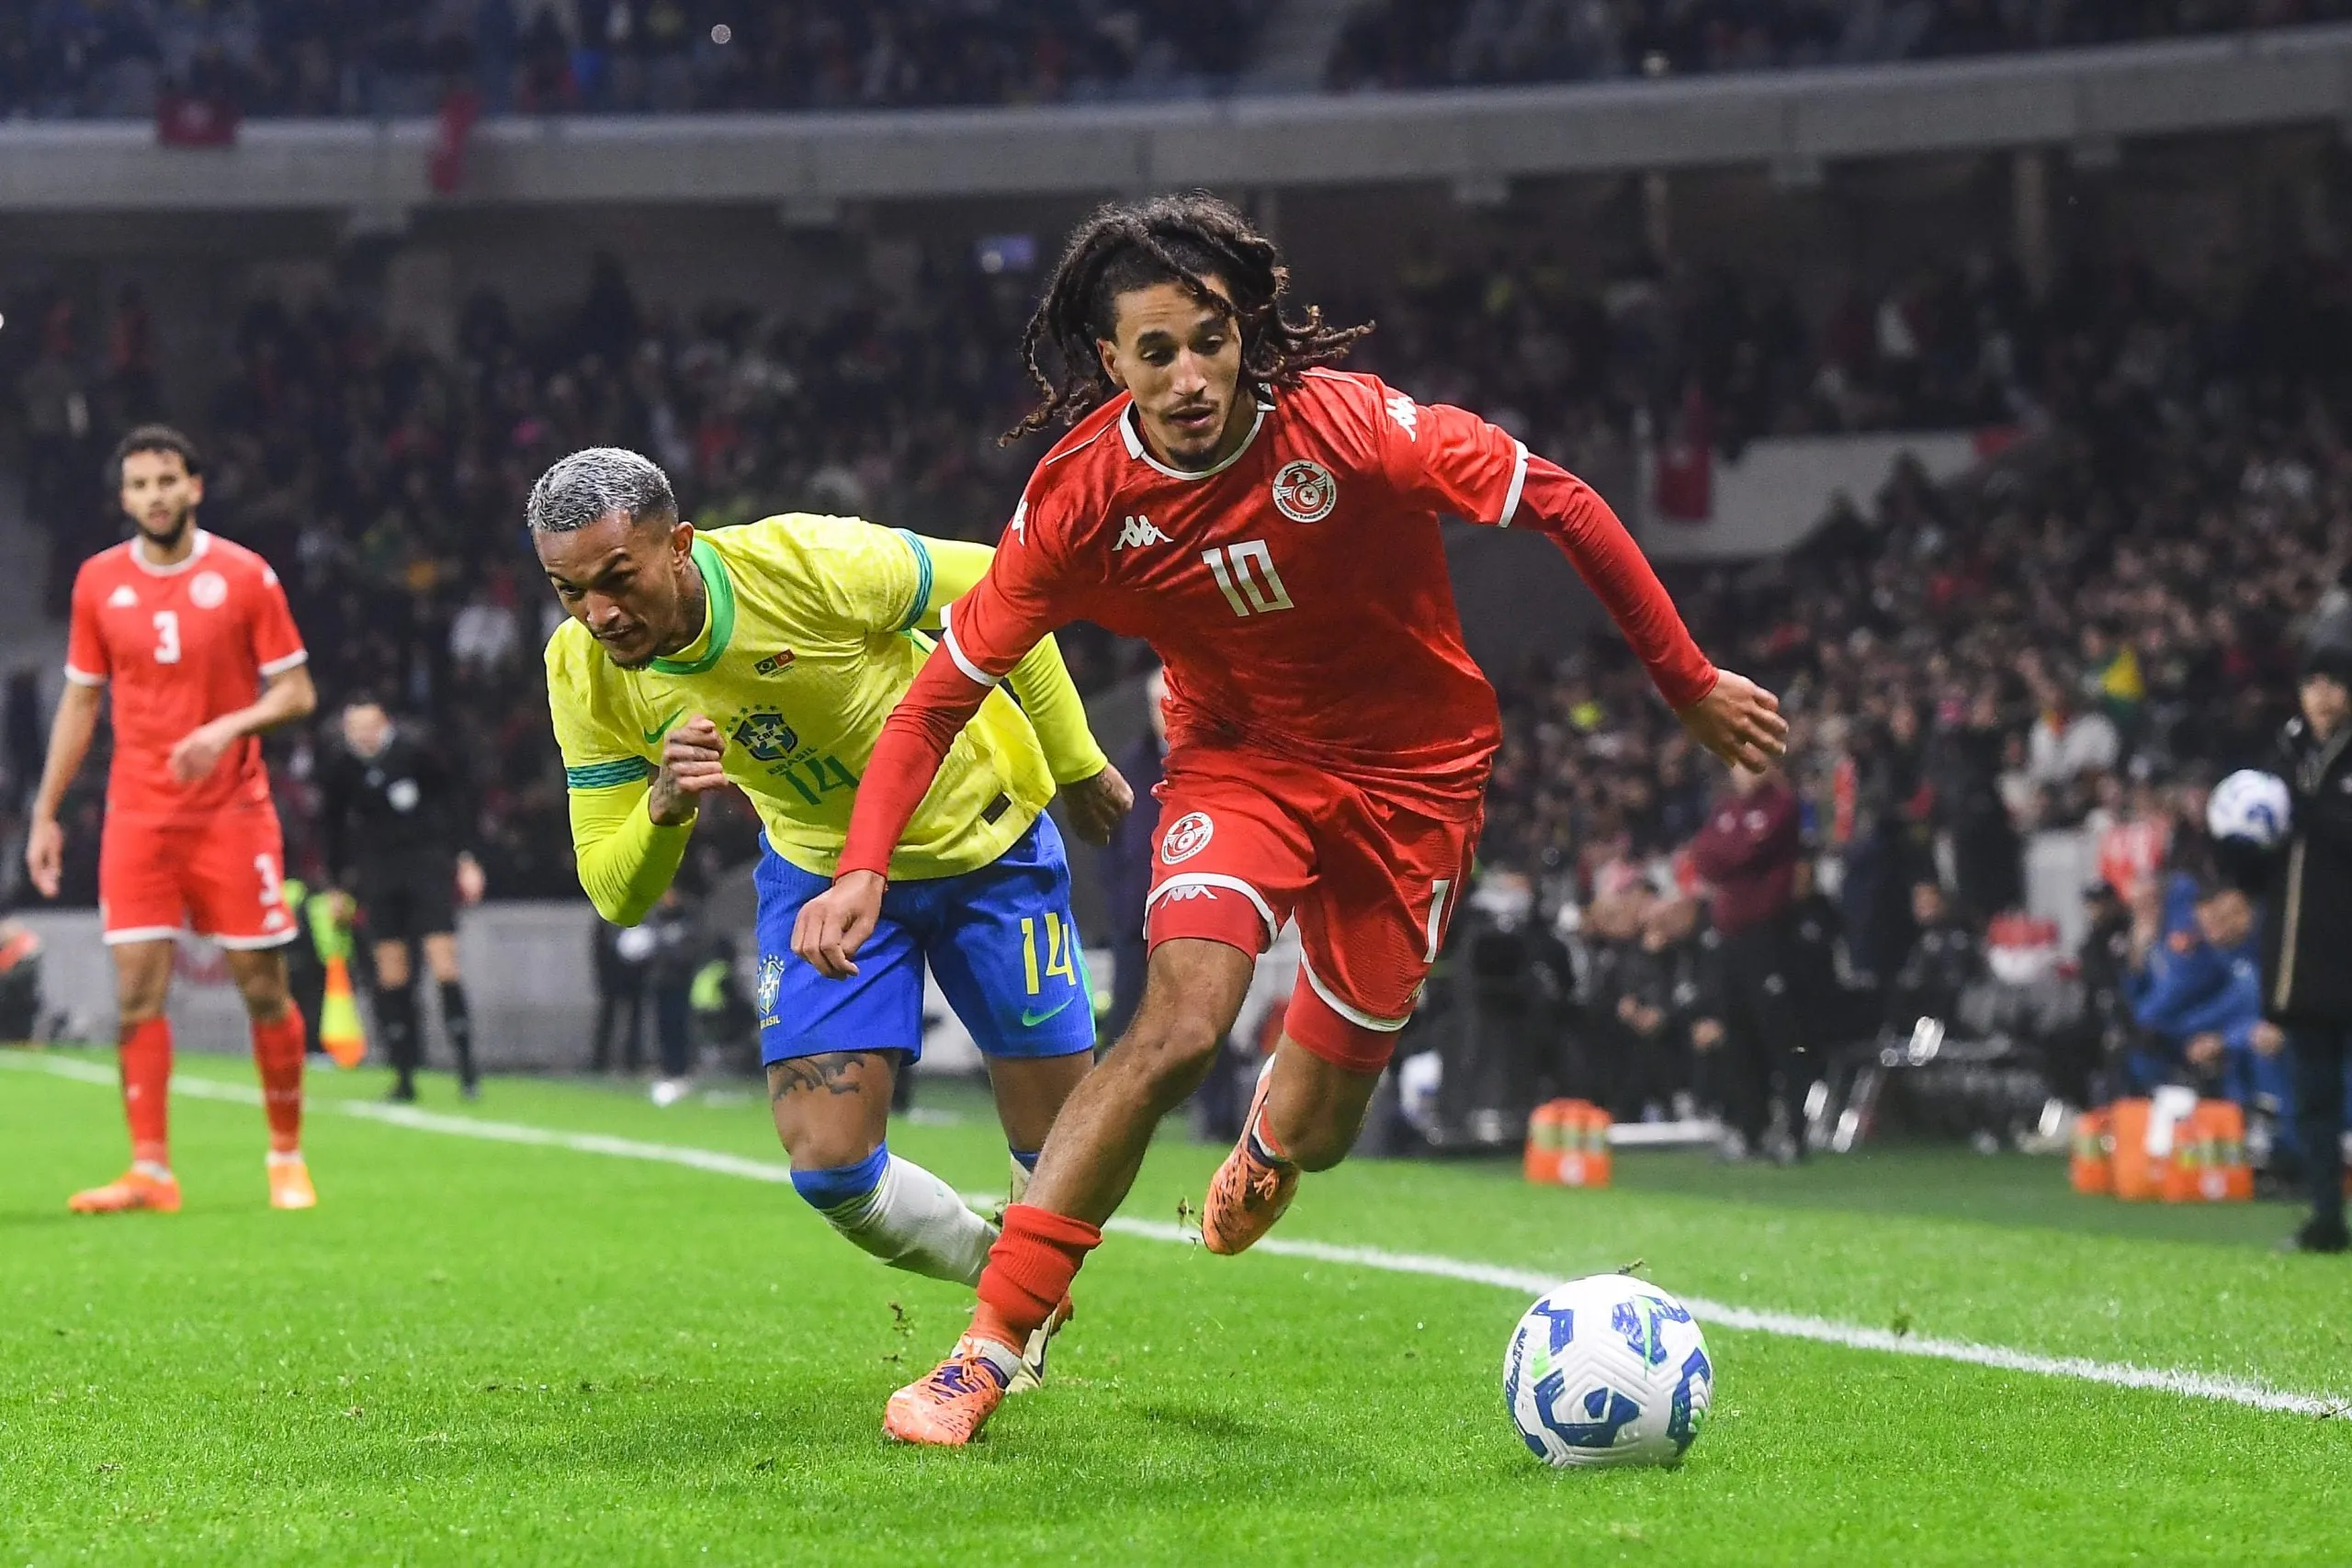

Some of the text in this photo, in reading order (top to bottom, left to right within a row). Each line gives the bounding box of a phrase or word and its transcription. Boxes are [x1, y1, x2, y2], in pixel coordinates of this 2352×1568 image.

[1202, 539, 1295, 617] 10
[153, 610, 180, 664] 3
[757, 729, 774, 741] CBF
[766, 746, 819, 775] BRASIL
[780, 755, 860, 806] 14
[254, 852, 279, 907] 3
[1021, 912, 1076, 995] 14
